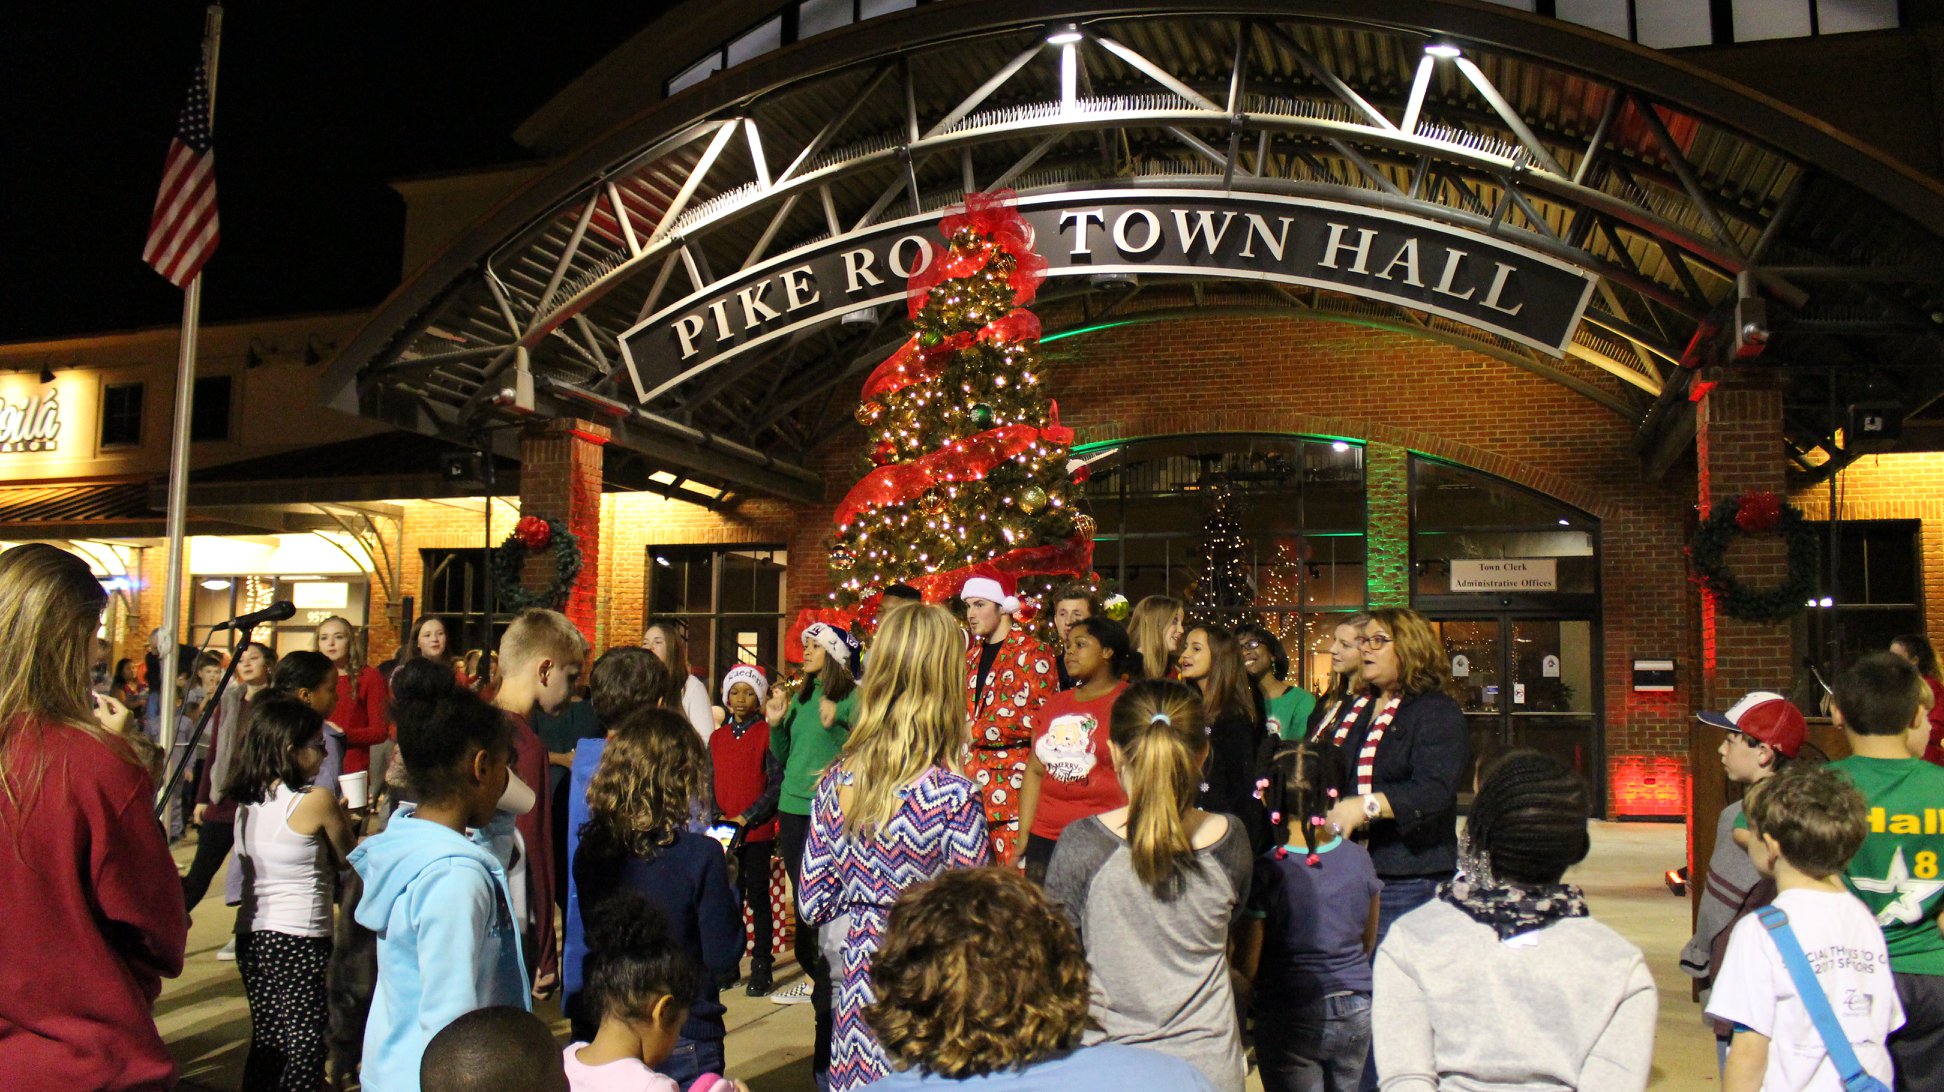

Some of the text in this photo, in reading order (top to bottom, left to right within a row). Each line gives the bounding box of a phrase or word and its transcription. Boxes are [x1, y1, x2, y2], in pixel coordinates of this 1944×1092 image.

[671, 266, 820, 360] PIKE
[1059, 207, 1295, 262] TOWN
[1316, 222, 1524, 317] HALL
[0, 387, 61, 443] oilá
[1480, 563, 1527, 571] Town Clerk
[1456, 579, 1552, 587] Administrative Offices
[1913, 850, 1939, 880] 8
